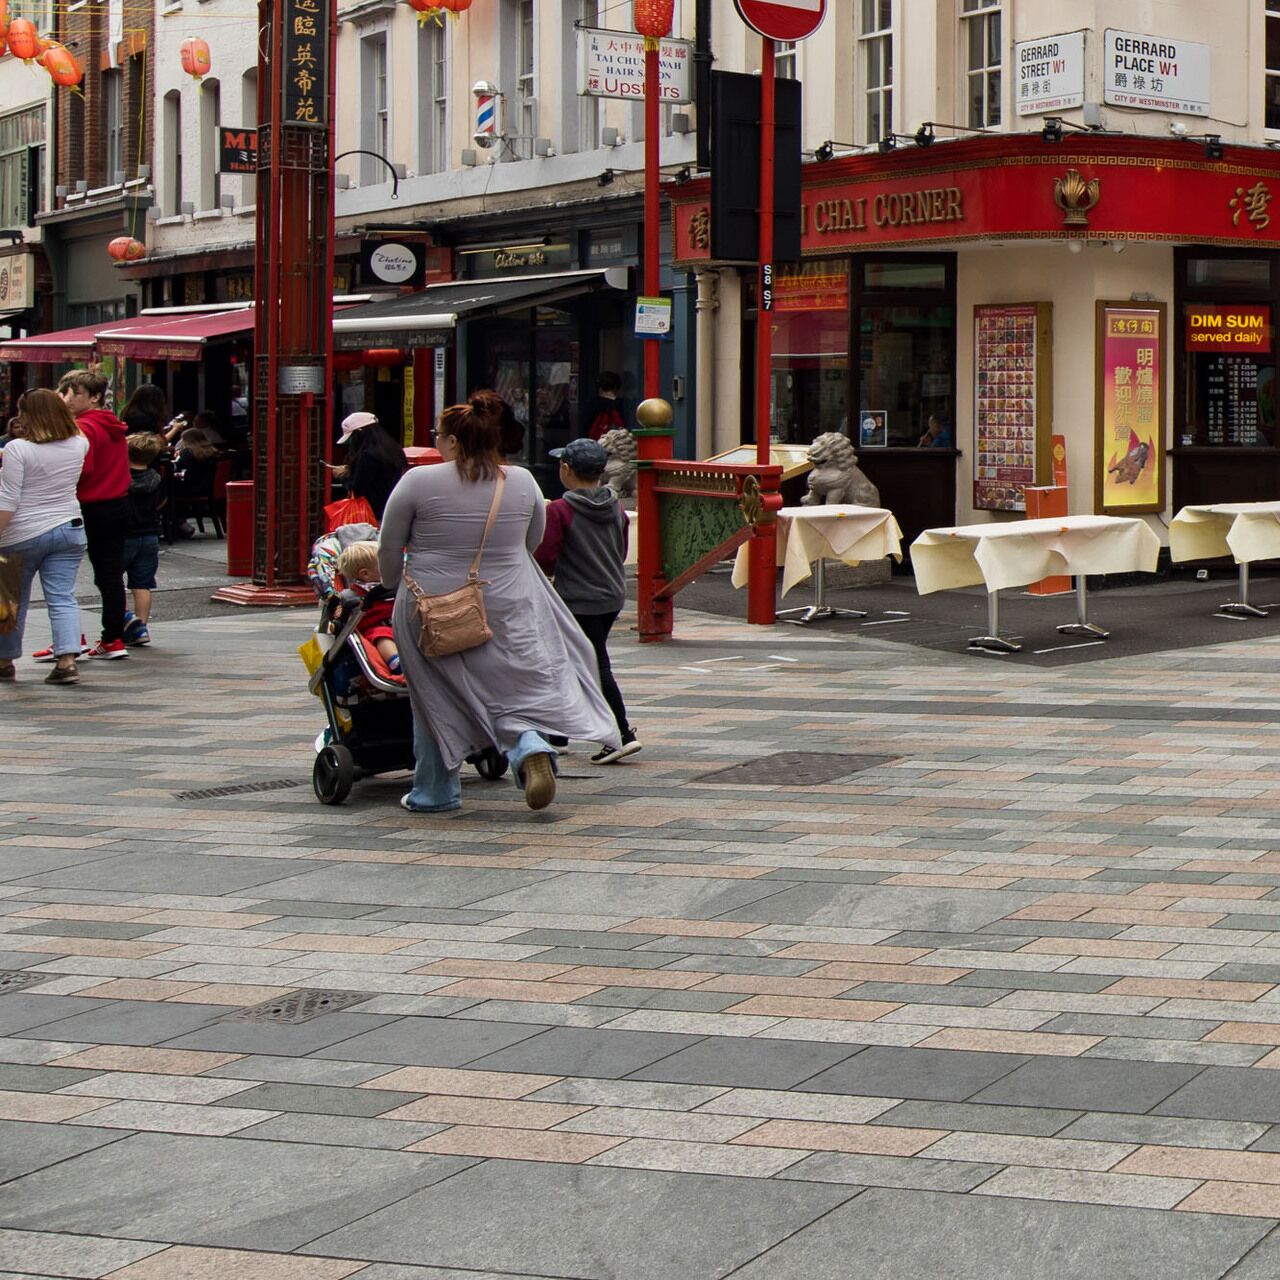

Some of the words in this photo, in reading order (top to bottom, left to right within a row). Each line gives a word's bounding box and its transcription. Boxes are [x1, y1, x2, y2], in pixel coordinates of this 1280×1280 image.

[607, 40, 687, 59] 大中華髮廊
[1021, 43, 1059, 63] GERRARD
[1115, 37, 1176, 59] GERRARD
[595, 53, 613, 63] TAI
[1115, 55, 1155, 73] PLACE
[1159, 61, 1178, 77] W1
[606, 66, 634, 77] HAIR
[638, 70, 672, 80] SON
[1021, 62, 1050, 80] STREET
[1053, 60, 1065, 74] W1
[604, 78, 680, 98] Upstirs
[1020, 103, 1029, 112] CITY
[1030, 102, 1035, 111] OF
[1035, 99, 1061, 110] WESTMINSTER
[1114, 94, 1128, 103] CITY
[1129, 96, 1137, 104] OF
[1139, 97, 1180, 109] WESTMINSTER
[815, 198, 867, 234] CHAI
[873, 187, 965, 229] CORNER
[1191, 315, 1222, 328] DIM
[1226, 315, 1264, 328] SUM
[1191, 332, 1232, 343] served
[1235, 331, 1263, 345] daily
